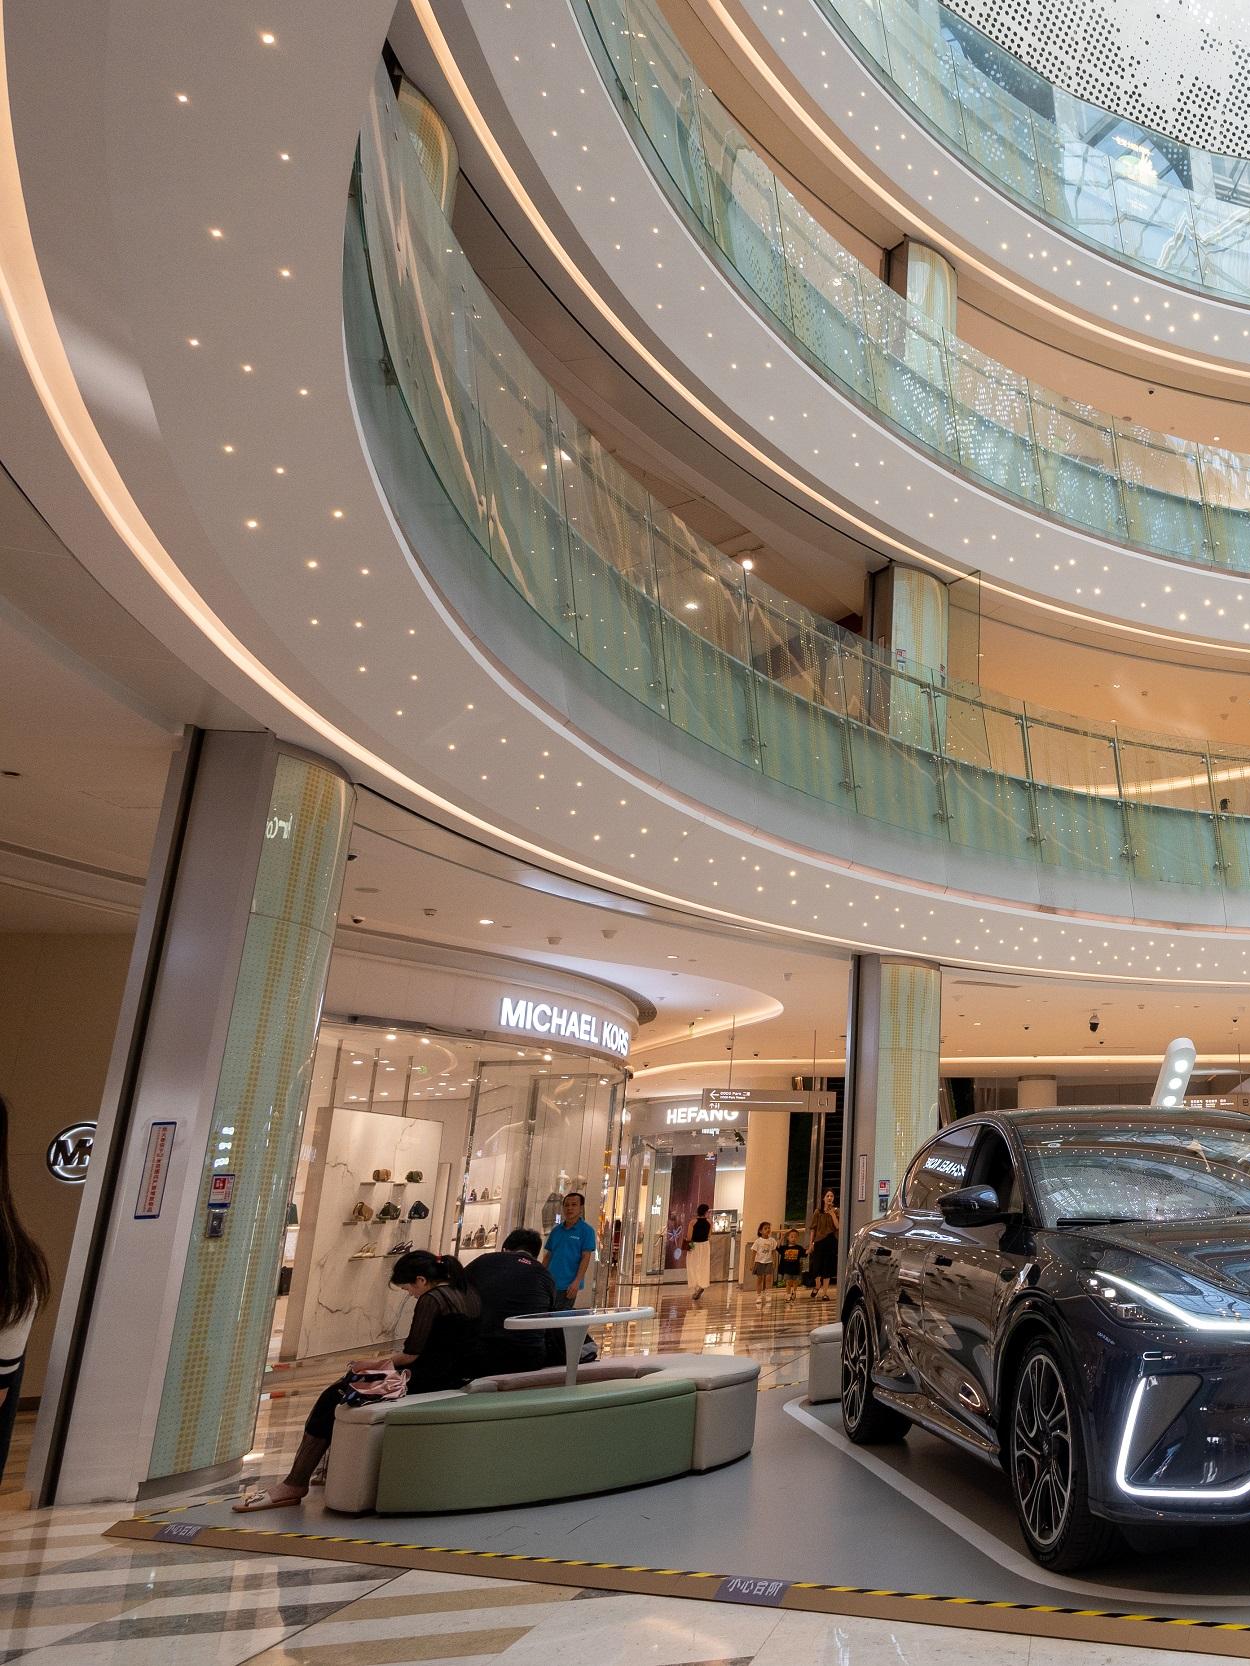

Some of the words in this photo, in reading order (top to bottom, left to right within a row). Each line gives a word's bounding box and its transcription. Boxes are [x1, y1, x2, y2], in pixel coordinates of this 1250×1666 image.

[500, 998, 598, 1043] MICHAEL
[602, 1021, 629, 1056] KORS
[666, 1106, 740, 1125] HEFANG
[727, 1579, 783, 1597] 小心台阶
